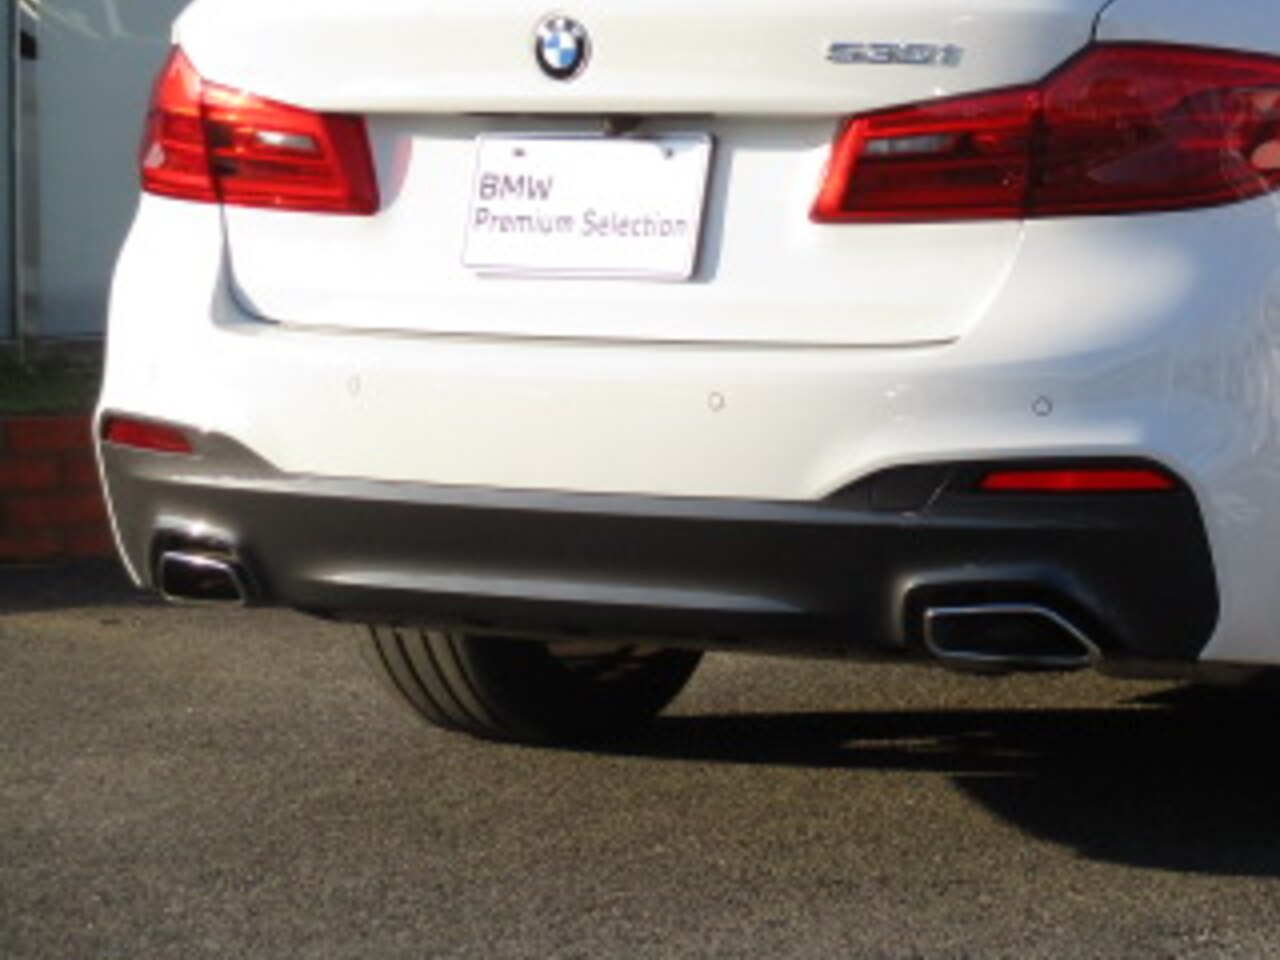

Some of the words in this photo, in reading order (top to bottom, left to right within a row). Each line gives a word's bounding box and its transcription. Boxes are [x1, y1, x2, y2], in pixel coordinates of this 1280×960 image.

[479, 173, 553, 201] BMW
[475, 206, 574, 234] Premium
[581, 208, 688, 238] Selection
